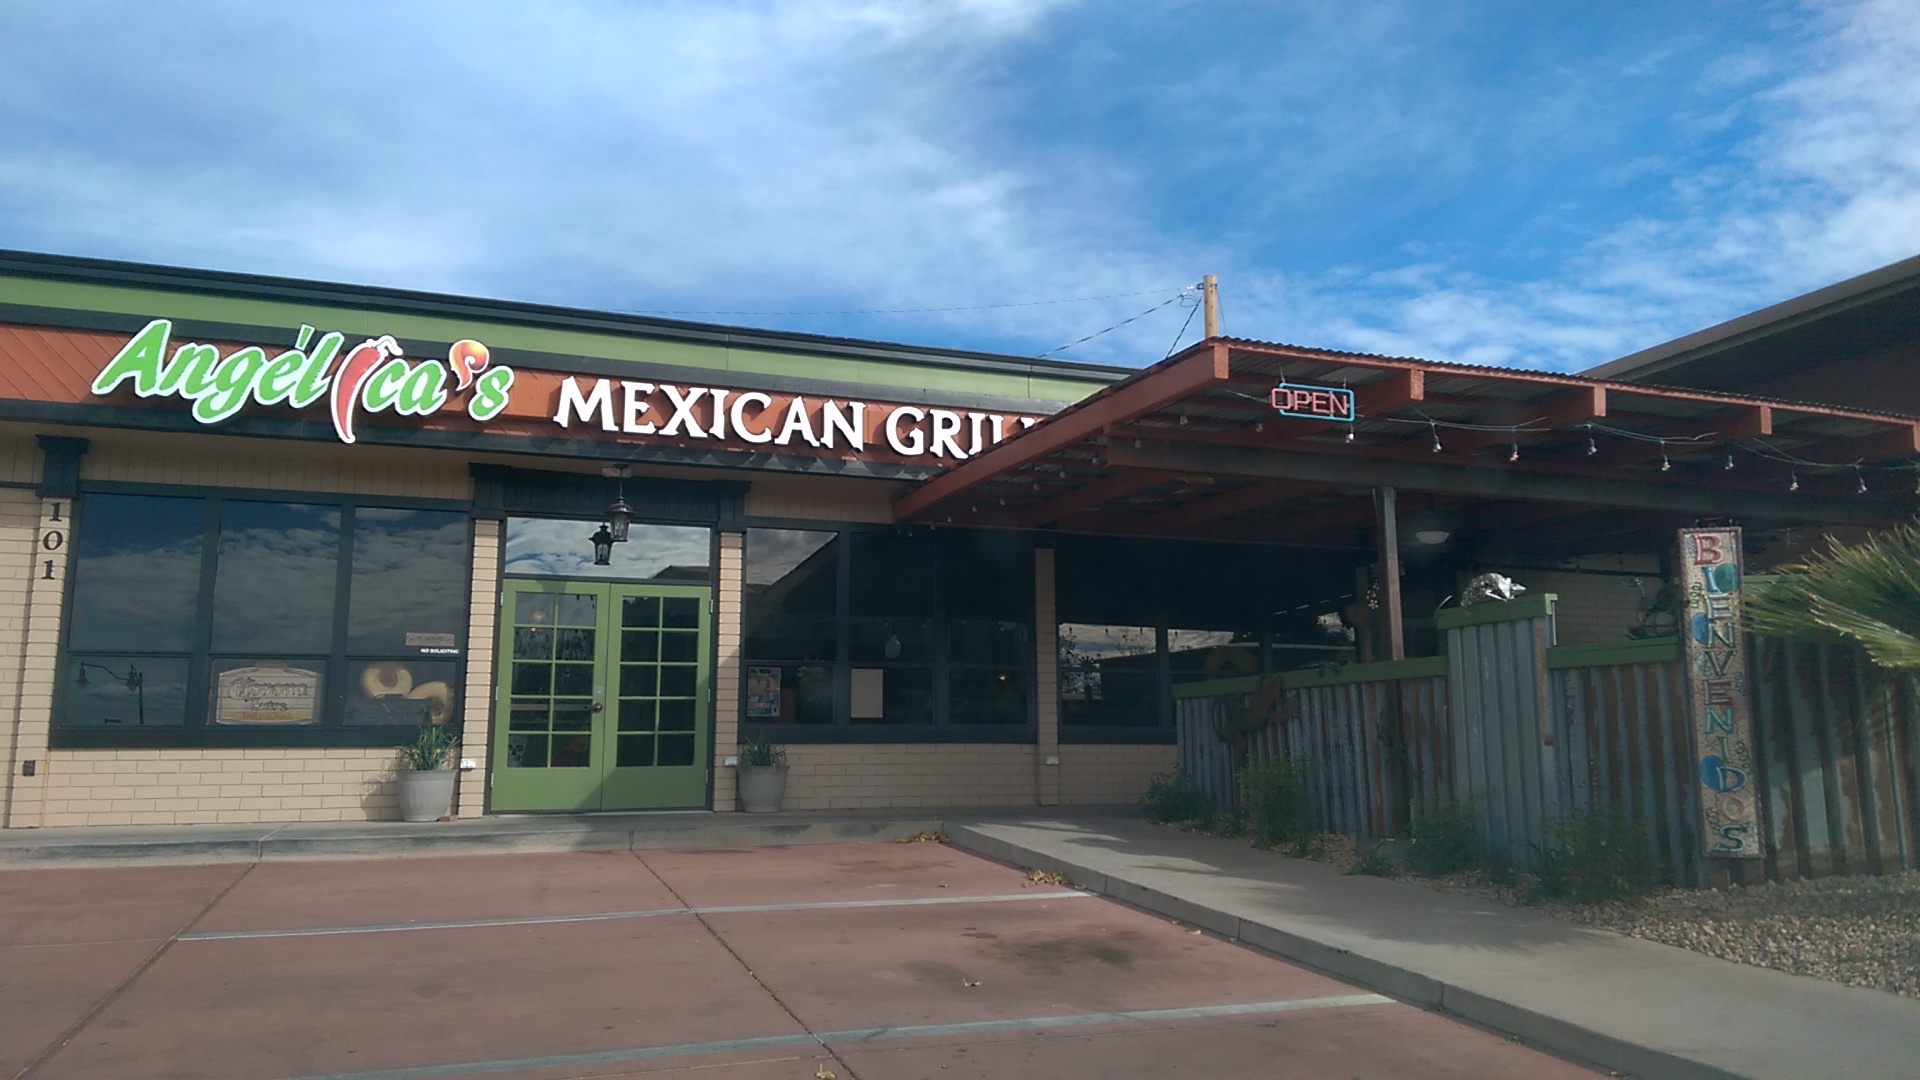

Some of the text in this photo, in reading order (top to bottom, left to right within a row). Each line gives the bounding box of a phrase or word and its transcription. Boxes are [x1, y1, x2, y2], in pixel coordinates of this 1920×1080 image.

[553, 375, 866, 453] MEXICAN
[886, 405, 1036, 460] GRI
[1271, 387, 1348, 415] OPEN
[41, 502, 63, 580] 101
[1693, 533, 1748, 851] BIENVENIDOS
